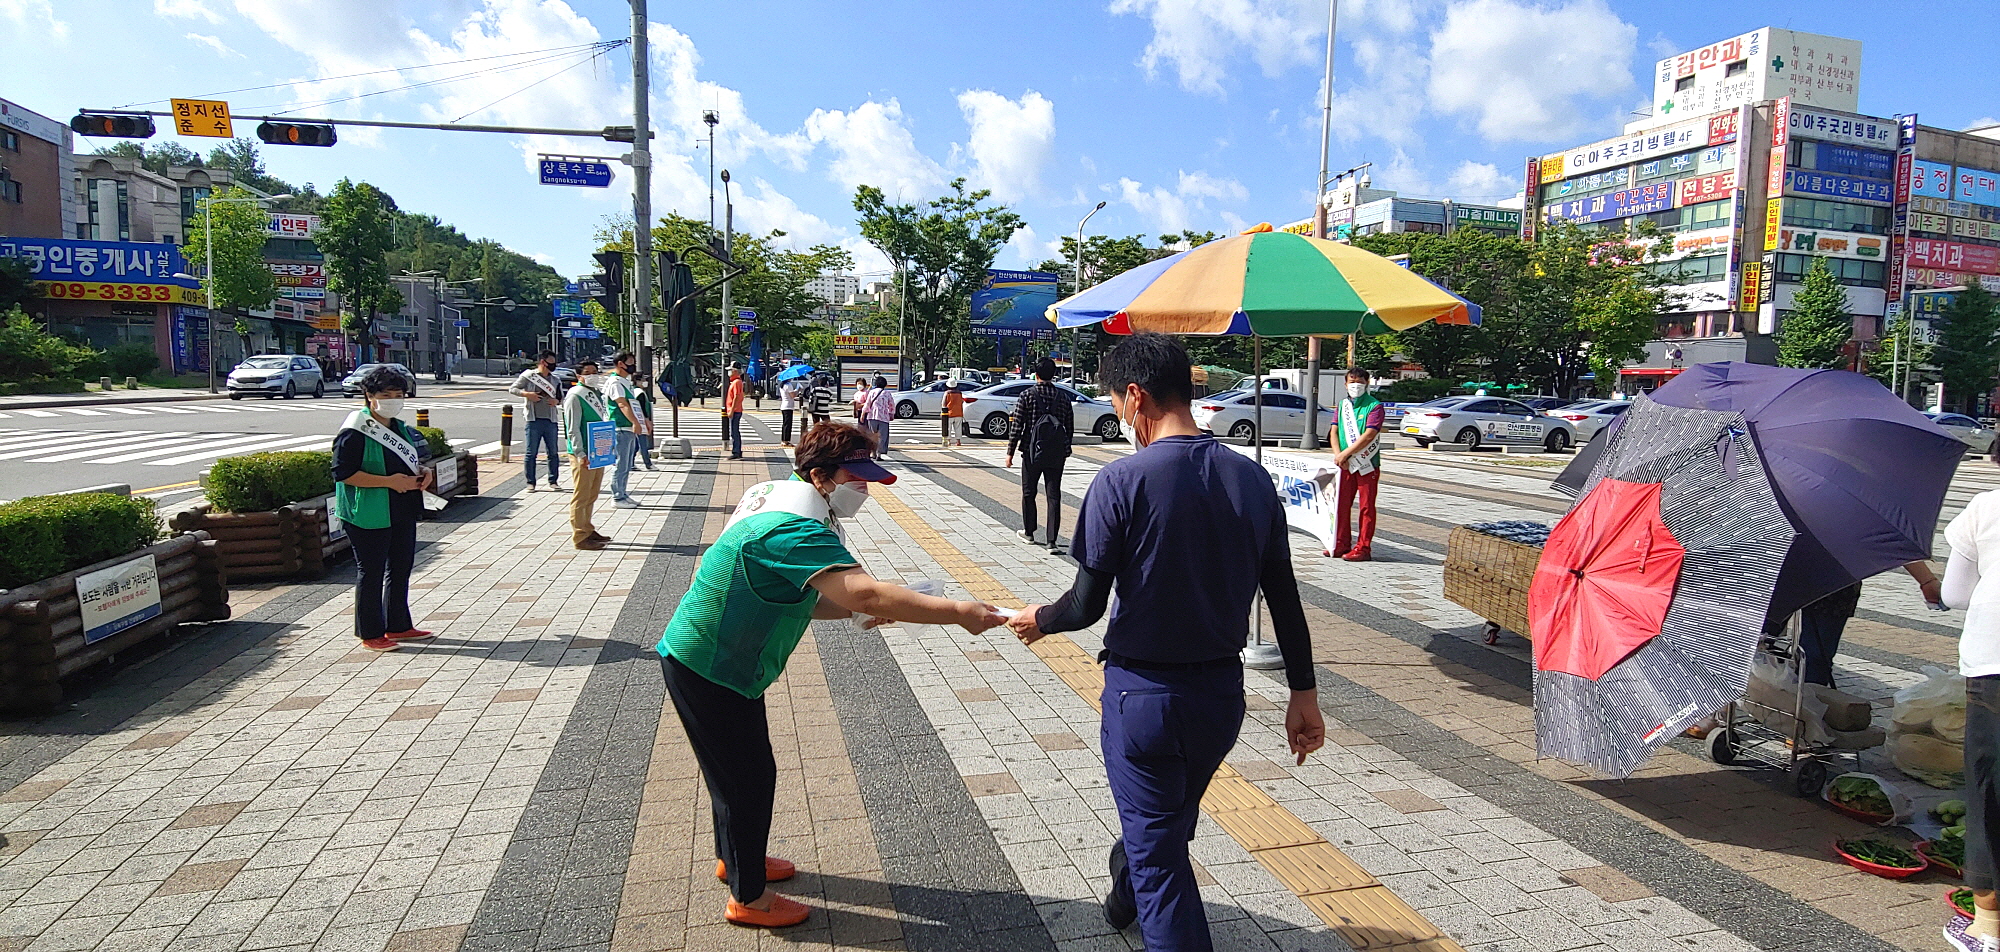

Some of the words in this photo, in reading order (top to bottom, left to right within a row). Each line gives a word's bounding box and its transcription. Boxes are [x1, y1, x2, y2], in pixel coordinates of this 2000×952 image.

[1677, 38, 1742, 77] 김안과
[1789, 73, 1812, 87] 피부과
[1817, 64, 1855, 81] 신경정신과
[1788, 87, 1812, 101] 약국
[177, 103, 226, 119] 정지선
[180, 119, 228, 135] 준수
[1803, 114, 1866, 140] 아주굿리빙텔
[1877, 130, 1888, 141] 4F
[1588, 131, 1674, 164] 아주굿리빙텔
[1678, 130, 1691, 148] 4F
[543, 162, 595, 176] 상록수로
[543, 176, 587, 185] Sangnoksu-ro
[1577, 169, 1629, 189] 아름다운
[1642, 147, 1724, 176] 피부과
[1683, 173, 1736, 198] 전당포
[1796, 175, 1890, 200] 아름다운피부과
[1912, 167, 1949, 193] 공정
[1960, 173, 1996, 197] 연대
[1614, 183, 1668, 207] 야간진료
[1457, 208, 1519, 224] 파출매니저
[157, 250, 170, 279] 사무소
[1914, 241, 1965, 269] 백치과
[1743, 271, 1758, 304] 인력개발
[82, 588, 101, 604] 보도는
[102, 581, 119, 597] 사람을
[132, 570, 157, 588] 거리입니다
